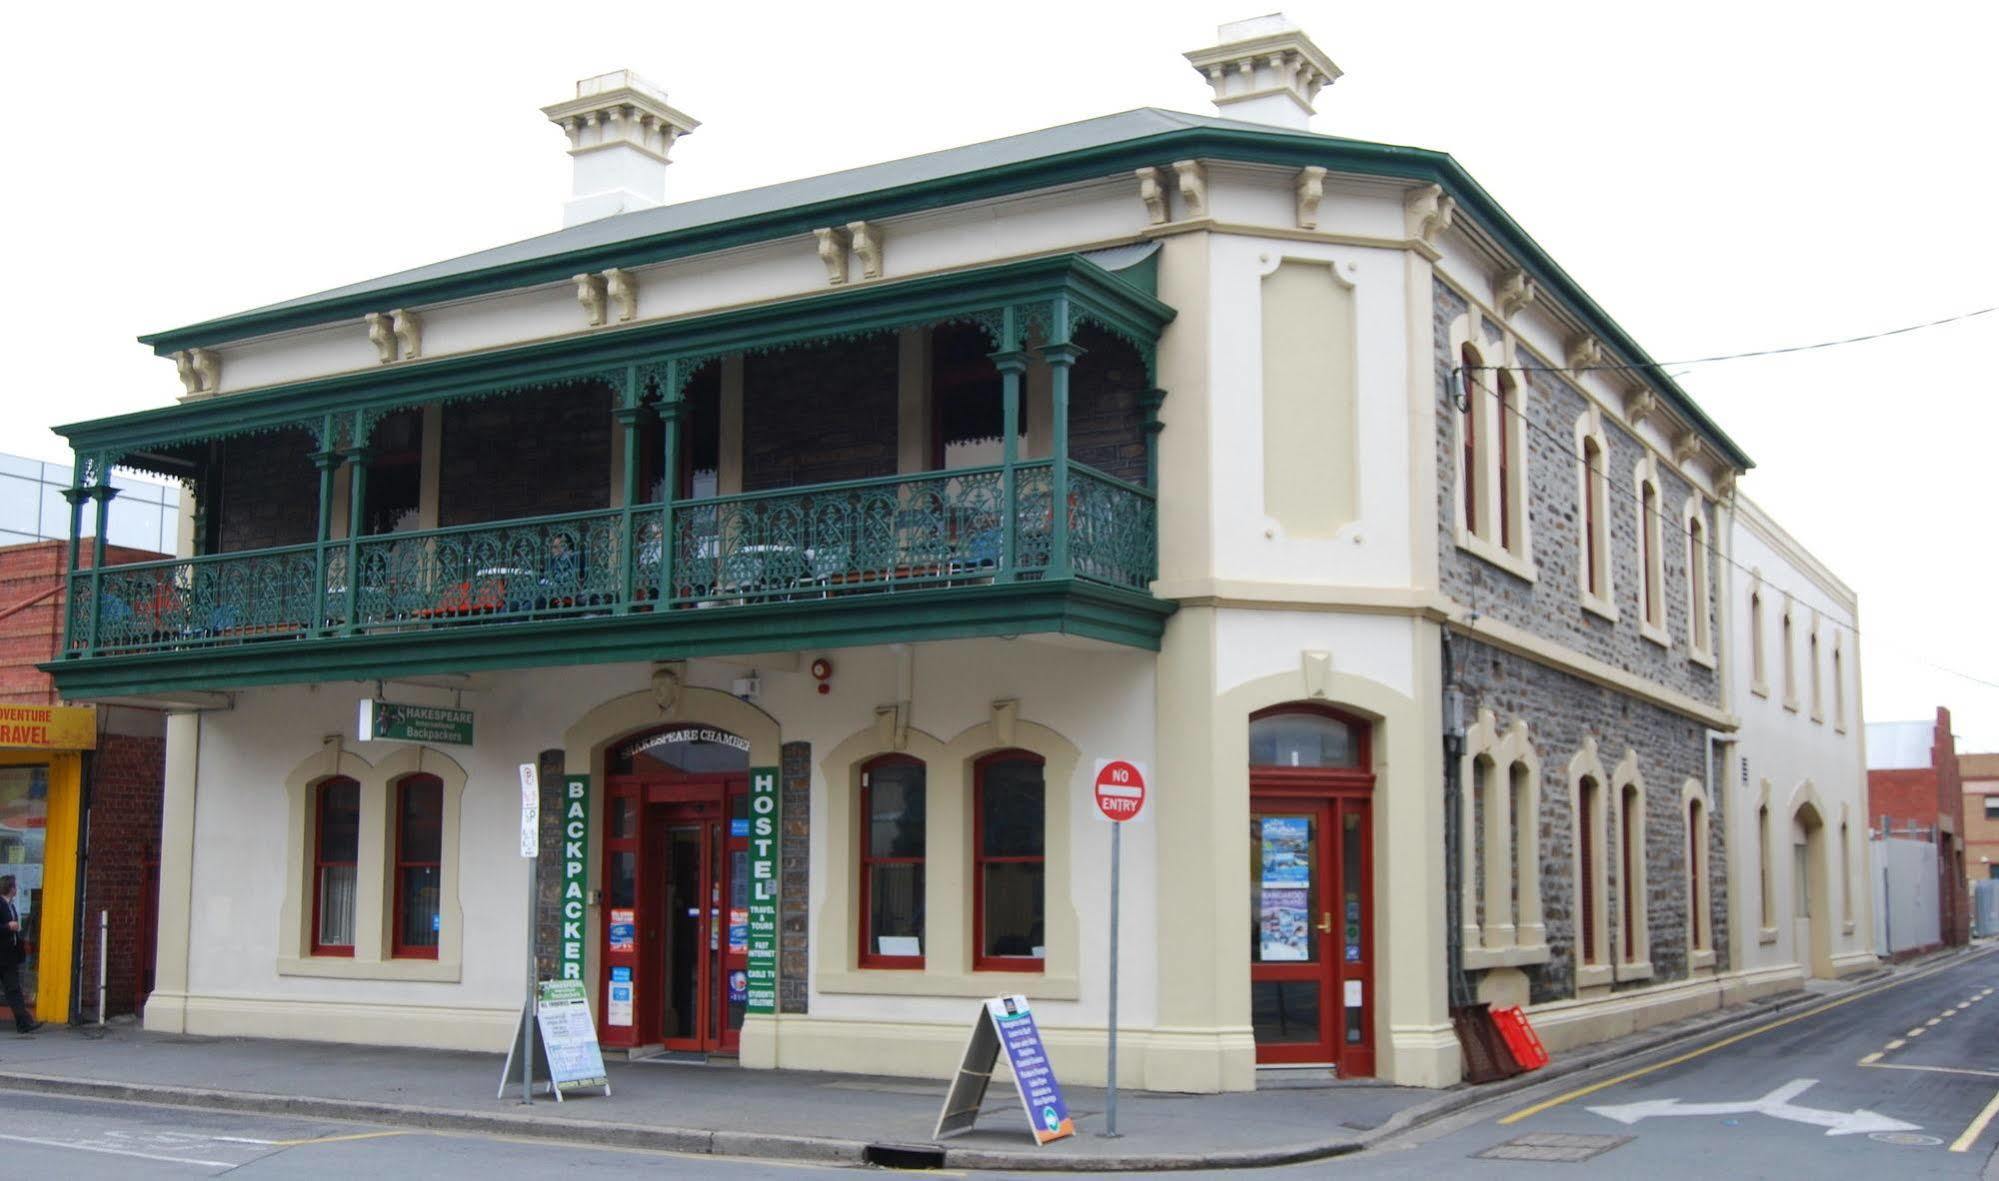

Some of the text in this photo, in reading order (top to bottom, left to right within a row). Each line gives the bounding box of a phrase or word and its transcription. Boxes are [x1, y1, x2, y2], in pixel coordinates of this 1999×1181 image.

[397, 704, 473, 725] SHAKESPEARE
[406, 726, 462, 743] Backpackers
[1112, 769, 1129, 783] NO
[1102, 797, 1139, 812] ENTRY
[754, 774, 774, 900] HOSTEL
[563, 782, 585, 980] BACKPACKER
[750, 906, 775, 914] TRAVEL
[751, 922, 774, 930] TOURS
